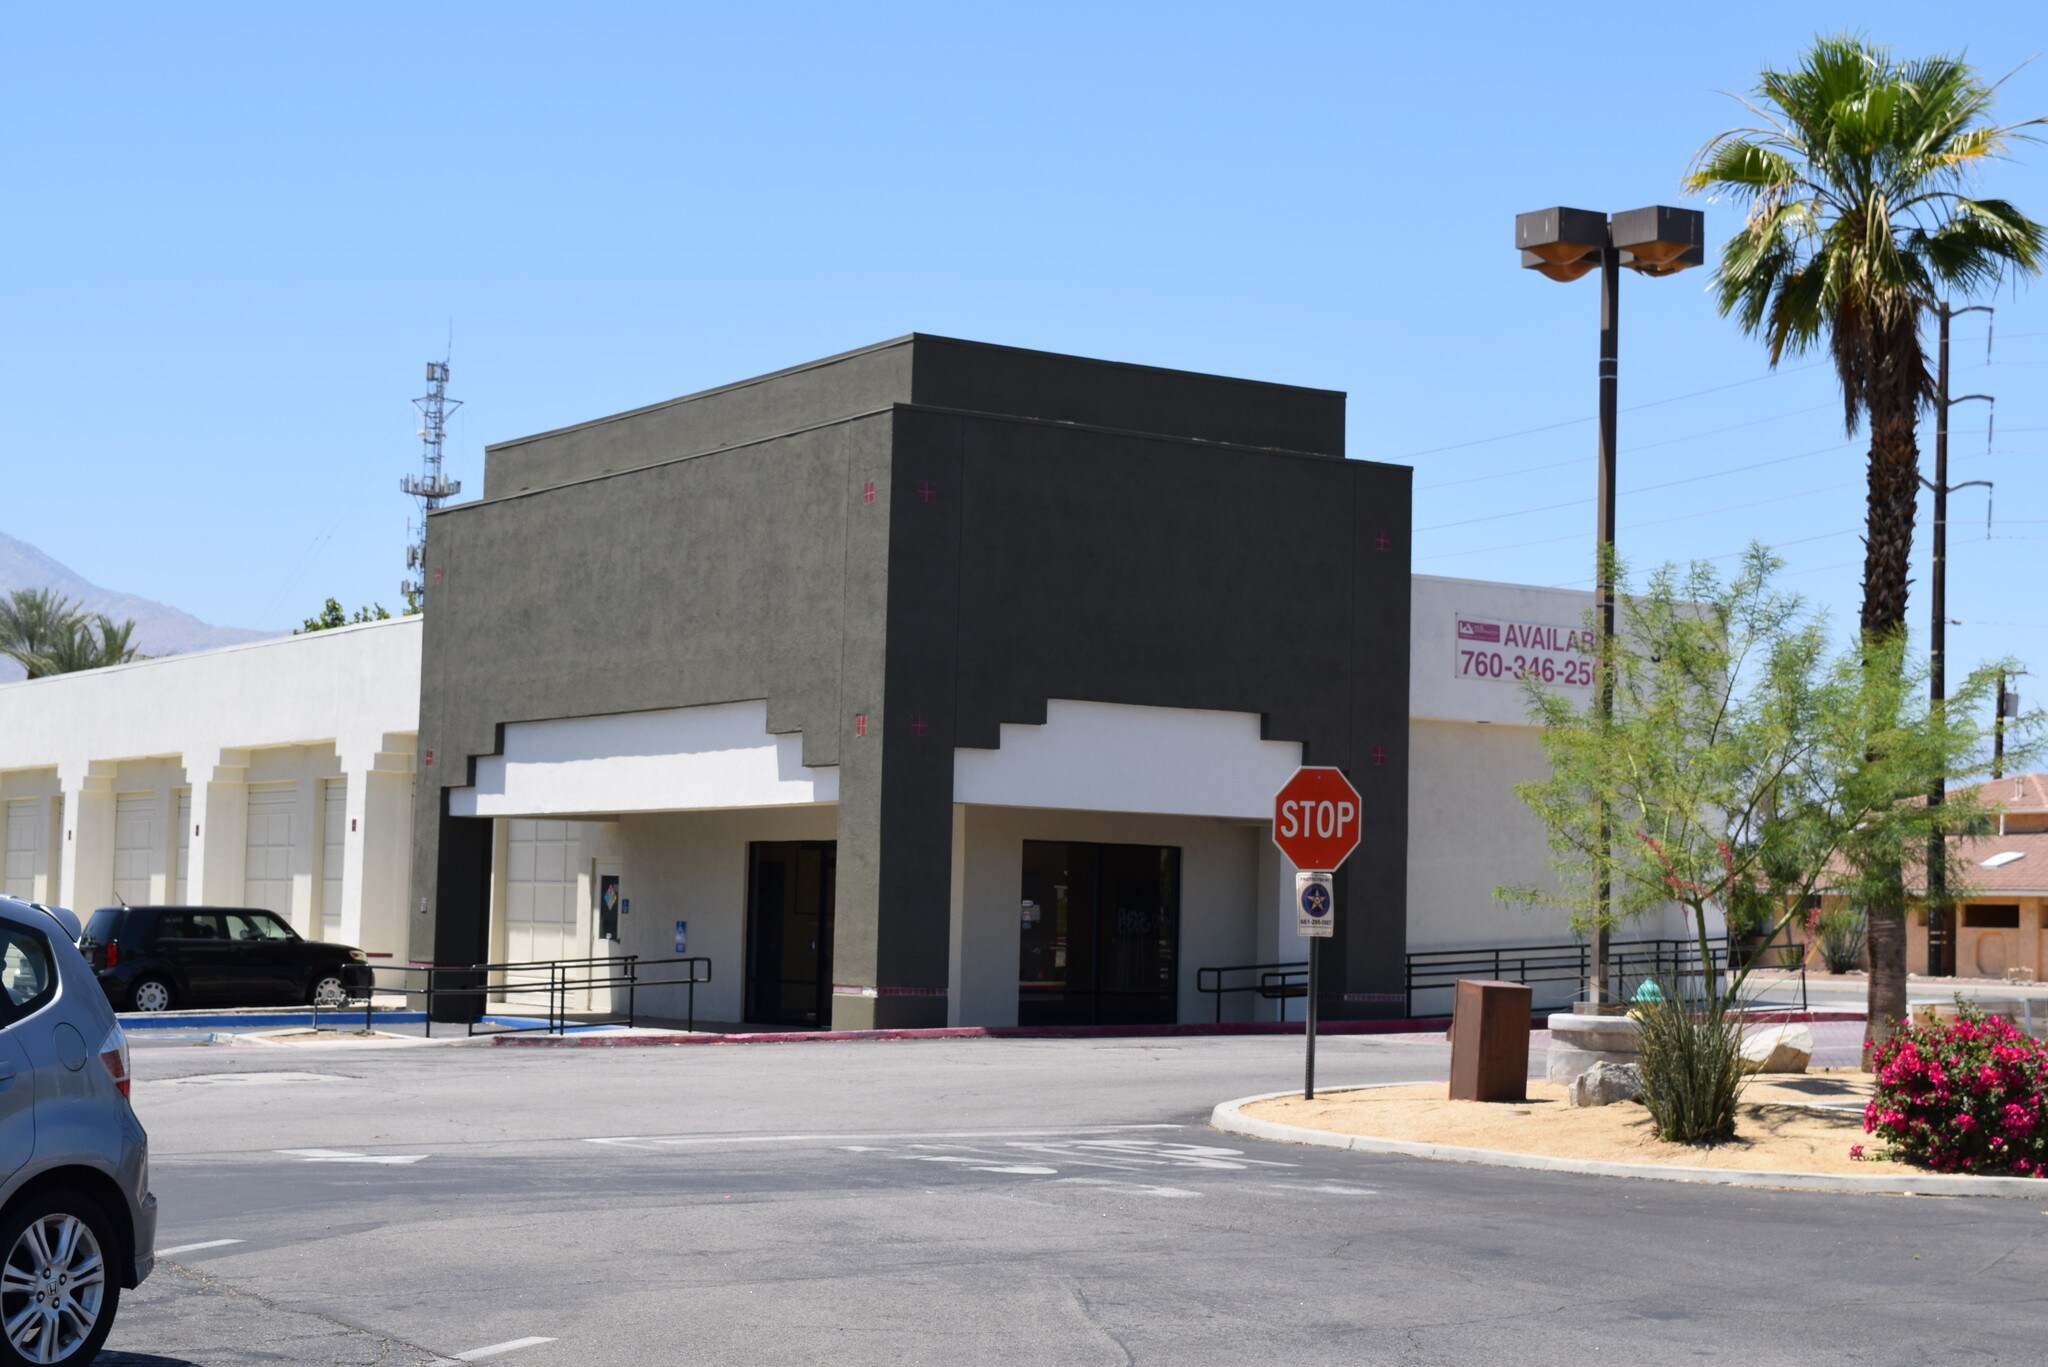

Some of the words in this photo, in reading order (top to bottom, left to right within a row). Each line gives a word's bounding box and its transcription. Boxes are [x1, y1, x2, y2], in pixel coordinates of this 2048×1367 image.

[1504, 624, 1617, 655] AVAILAB
[1461, 650, 1617, 688] 760-346-25
[1280, 800, 1355, 838] STOP
